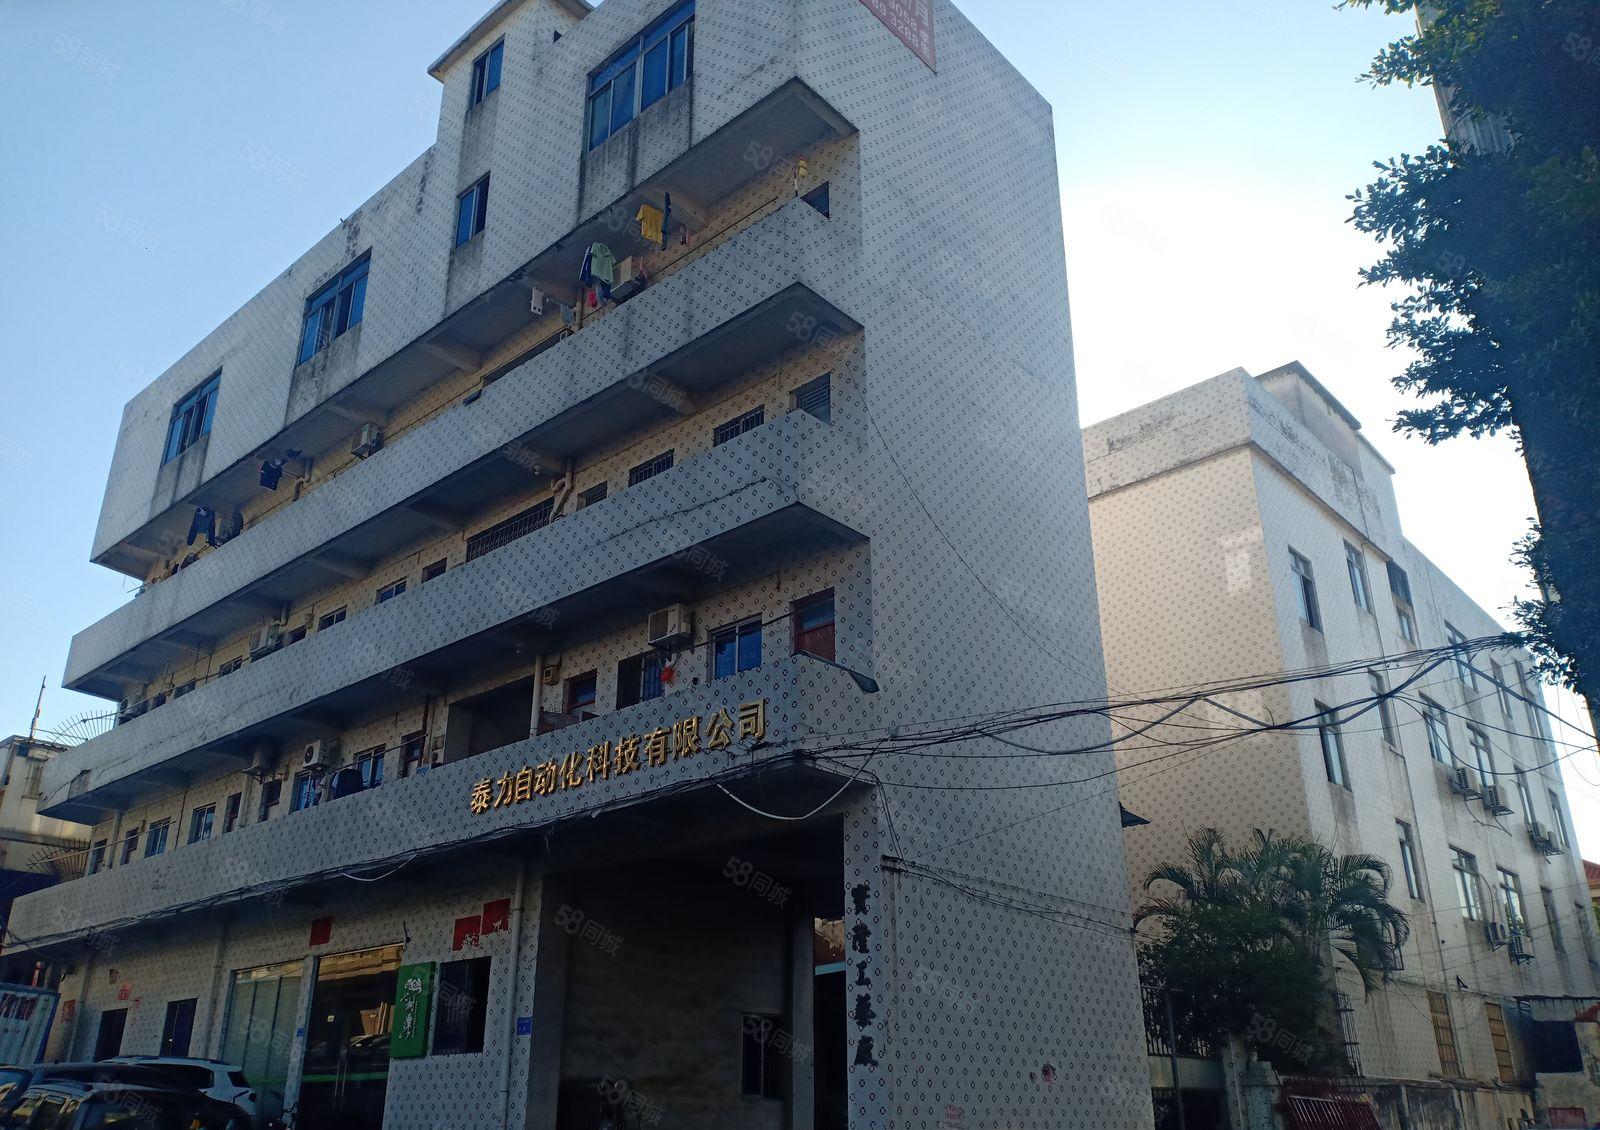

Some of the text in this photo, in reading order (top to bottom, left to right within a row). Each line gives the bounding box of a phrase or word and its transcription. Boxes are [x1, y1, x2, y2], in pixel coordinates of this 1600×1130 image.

[470, 699, 767, 814] 泰力自动化科技有限公司
